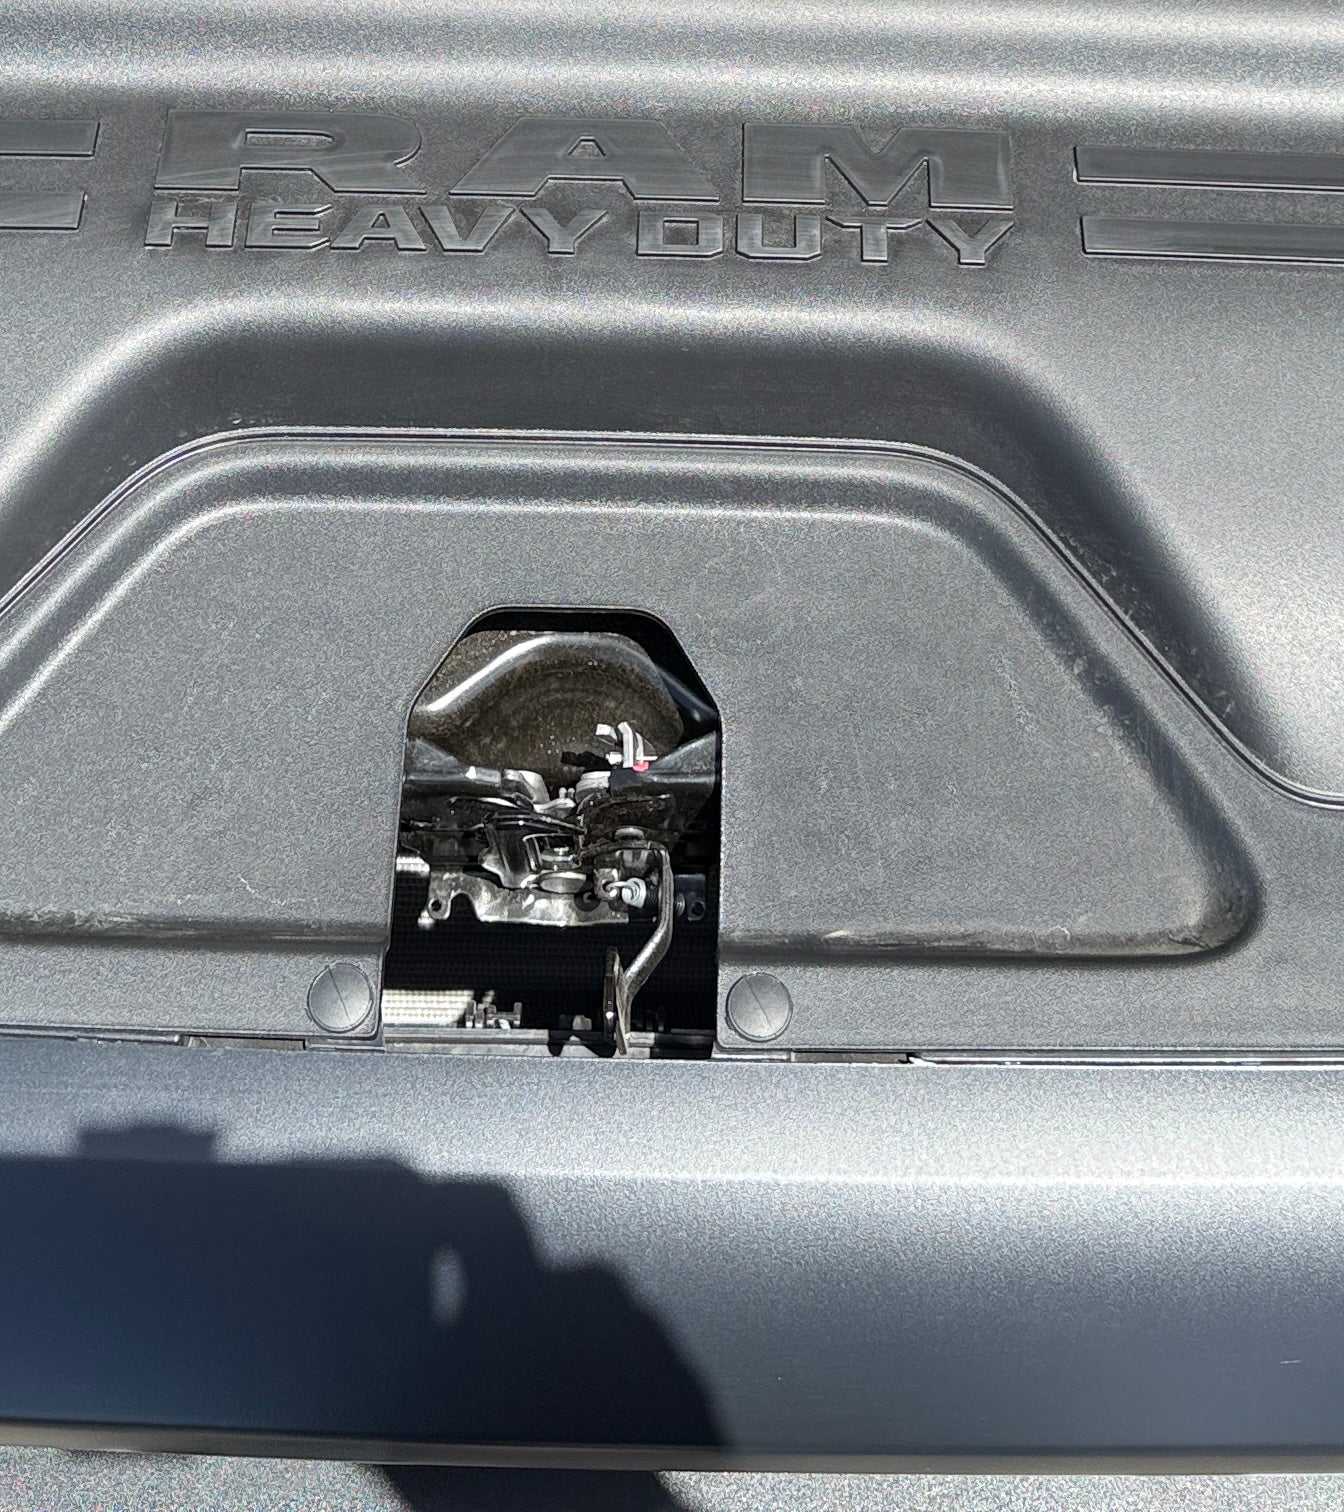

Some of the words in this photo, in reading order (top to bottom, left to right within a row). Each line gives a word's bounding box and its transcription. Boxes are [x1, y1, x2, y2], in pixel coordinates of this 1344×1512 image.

[154, 109, 1014, 210] RAM
[144, 201, 609, 257] HEAVY
[636, 212, 1016, 266] DUTY
